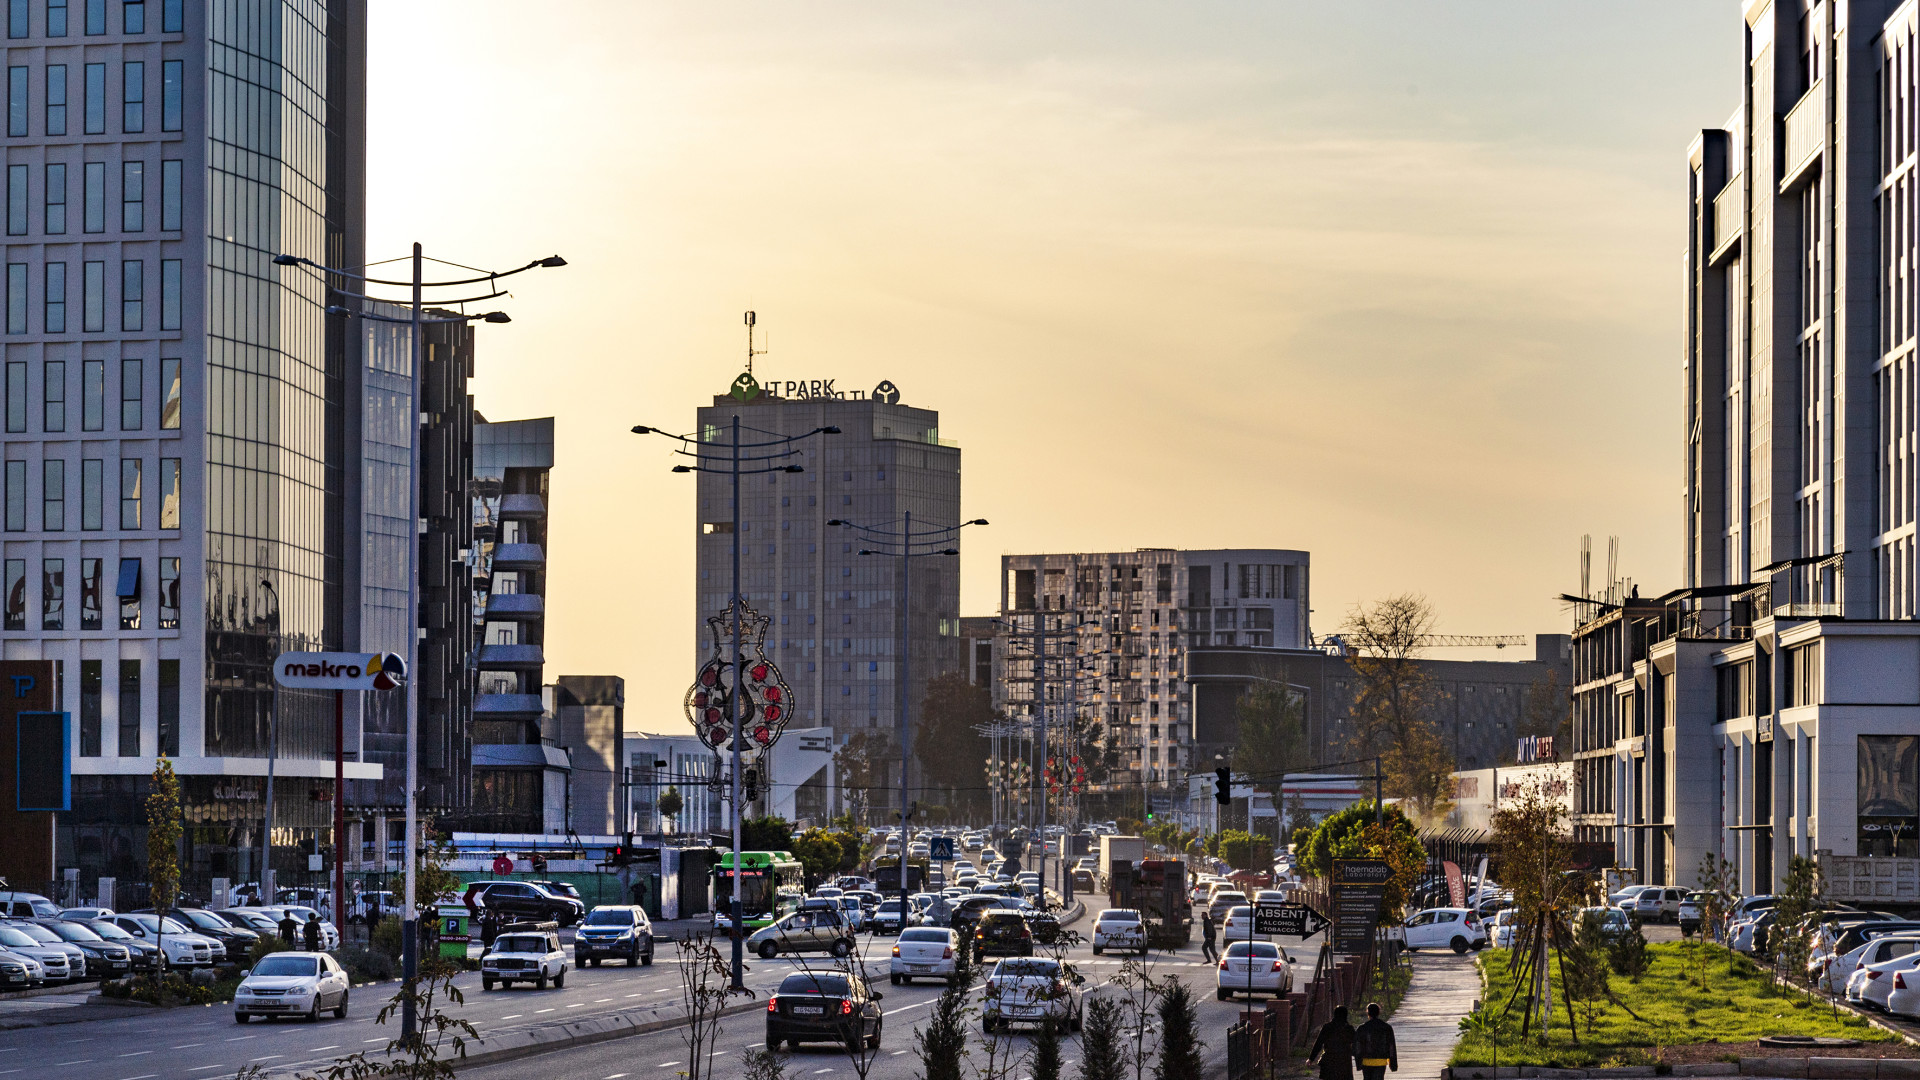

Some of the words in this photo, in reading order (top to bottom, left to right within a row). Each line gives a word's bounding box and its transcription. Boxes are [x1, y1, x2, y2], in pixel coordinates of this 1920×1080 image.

[765, 381, 781, 398] IT
[786, 379, 835, 400] PARK
[284, 660, 361, 678] makro
[1345, 865, 1387, 873] haemalab
[1256, 908, 1305, 919] ABSENT
[449, 920, 457, 930] P
